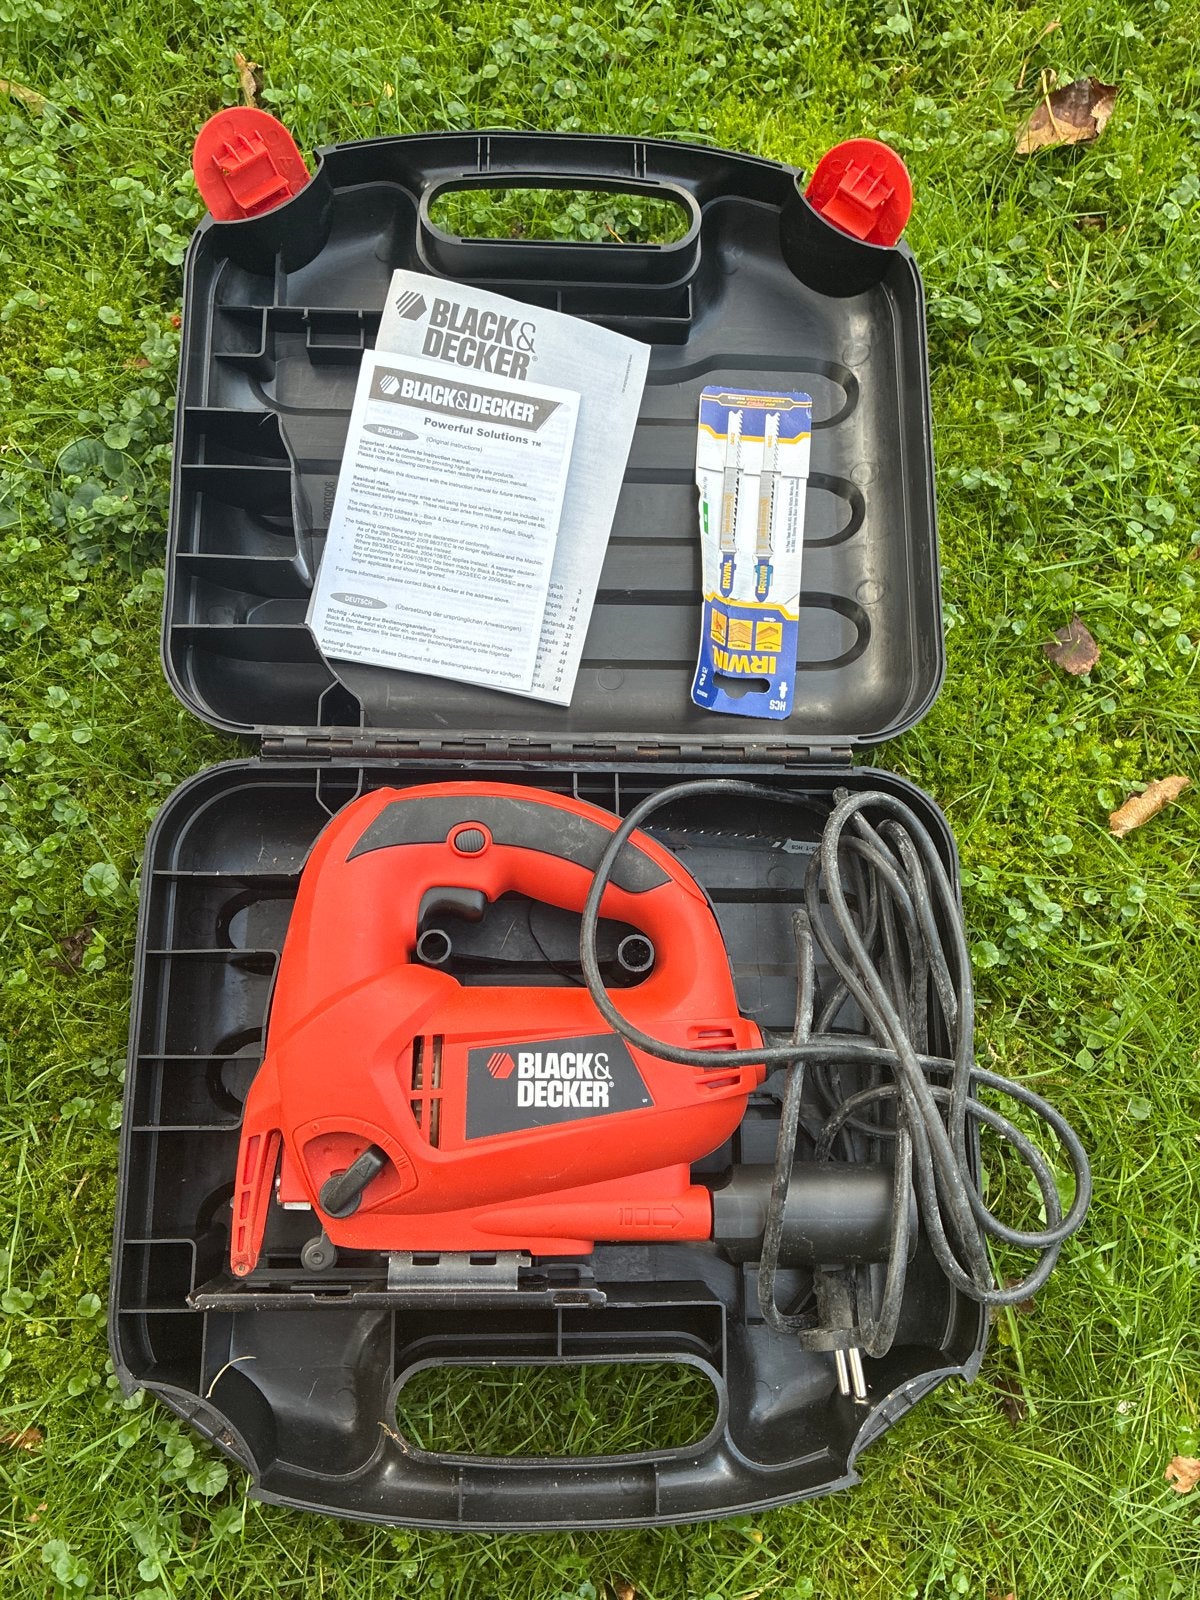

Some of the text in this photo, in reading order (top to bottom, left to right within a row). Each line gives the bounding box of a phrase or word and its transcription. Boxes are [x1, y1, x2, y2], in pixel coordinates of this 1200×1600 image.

[429, 298, 536, 353] BLACK&
[378, 427, 403, 437] ENGLISH
[424, 417, 473, 435] Powerful
[477, 428, 528, 445] Solutions
[360, 439, 384, 447] Important
[388, 444, 415, 453] Addendum
[426, 436, 482, 453] (Original instructions)
[353, 475, 375, 483] Residual
[355, 463, 378, 472] Warning!
[405, 473, 428, 481] document
[344, 595, 373, 606] DEUTSCH
[769, 699, 786, 711] HCS
[518, 1052, 612, 1079] BLACK&
